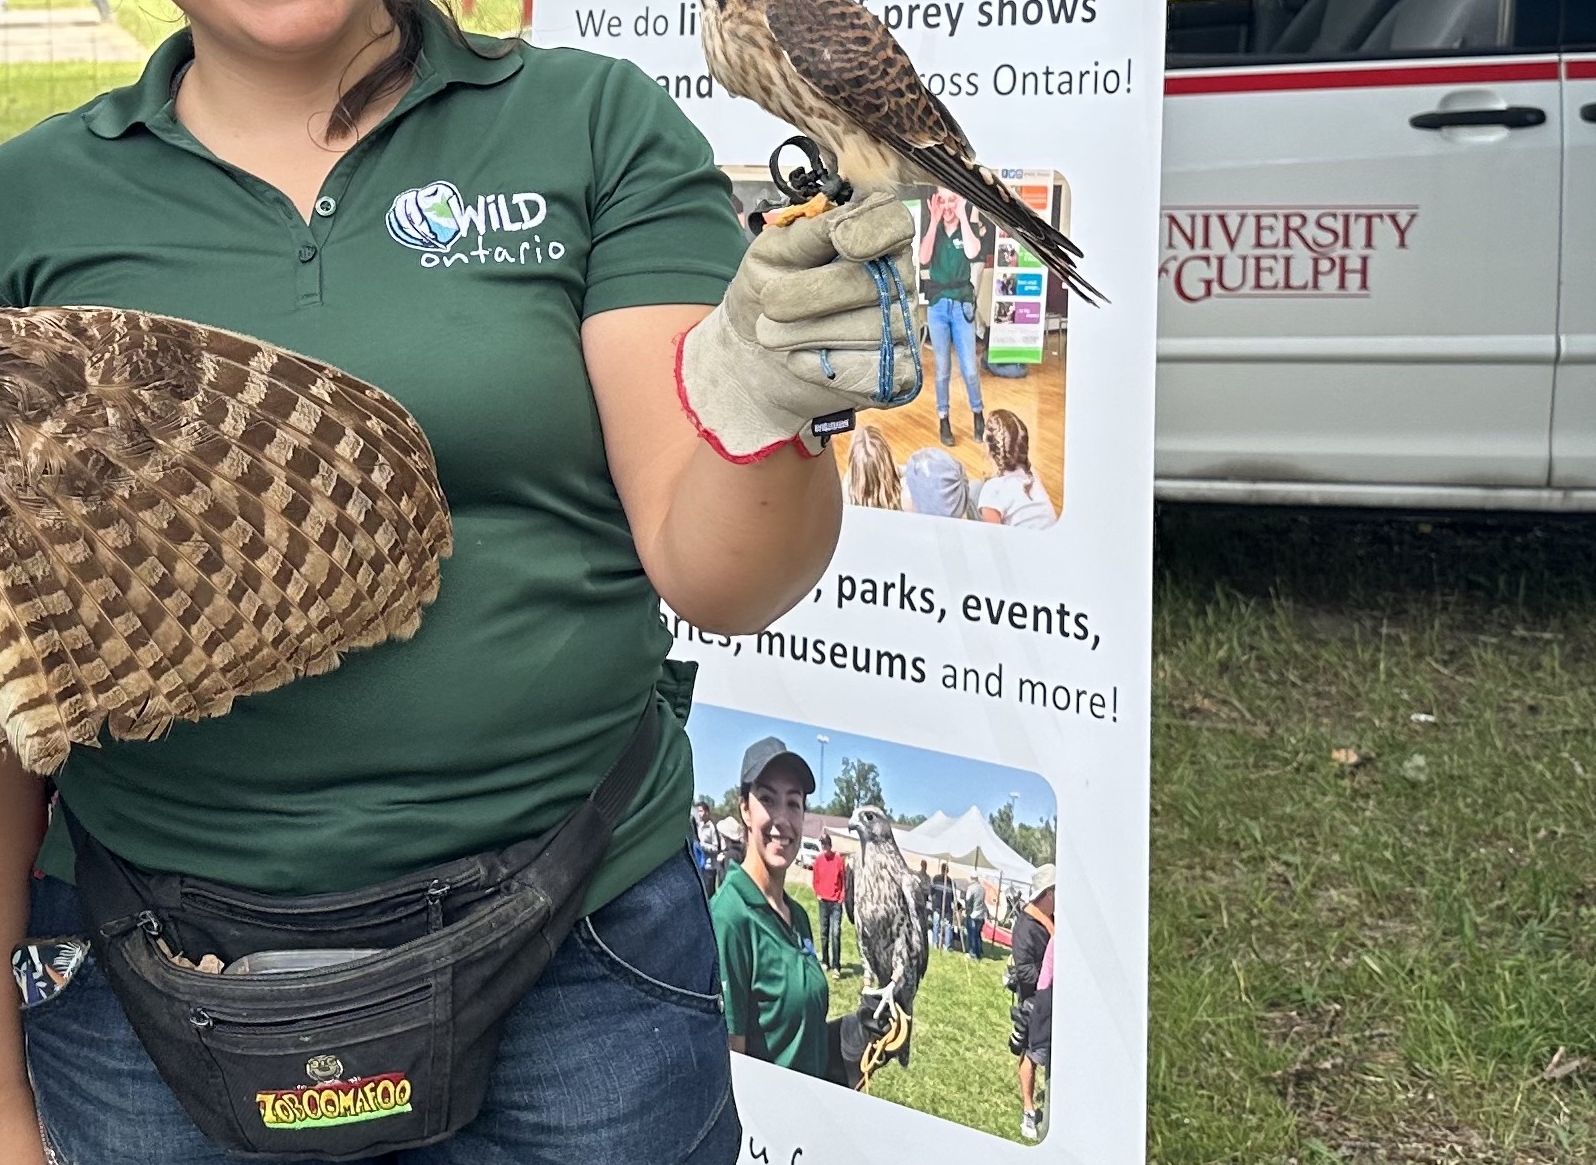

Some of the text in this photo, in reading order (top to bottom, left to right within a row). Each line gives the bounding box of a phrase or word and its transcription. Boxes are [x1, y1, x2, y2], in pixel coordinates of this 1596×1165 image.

[576, 8, 622, 37] We
[634, 5, 669, 37] do
[884, 2, 964, 37] prey
[656, 73, 713, 99] and
[993, 58, 1132, 96] Ontario!
[420, 235, 566, 268] ontario
[1161, 212, 1418, 255] NIVERSITY
[1174, 254, 1370, 303] GUELPH
[837, 572, 1102, 651] parks, events,
[756, 628, 927, 684] museums
[941, 662, 1004, 699] and
[1017, 676, 1119, 723] more!
